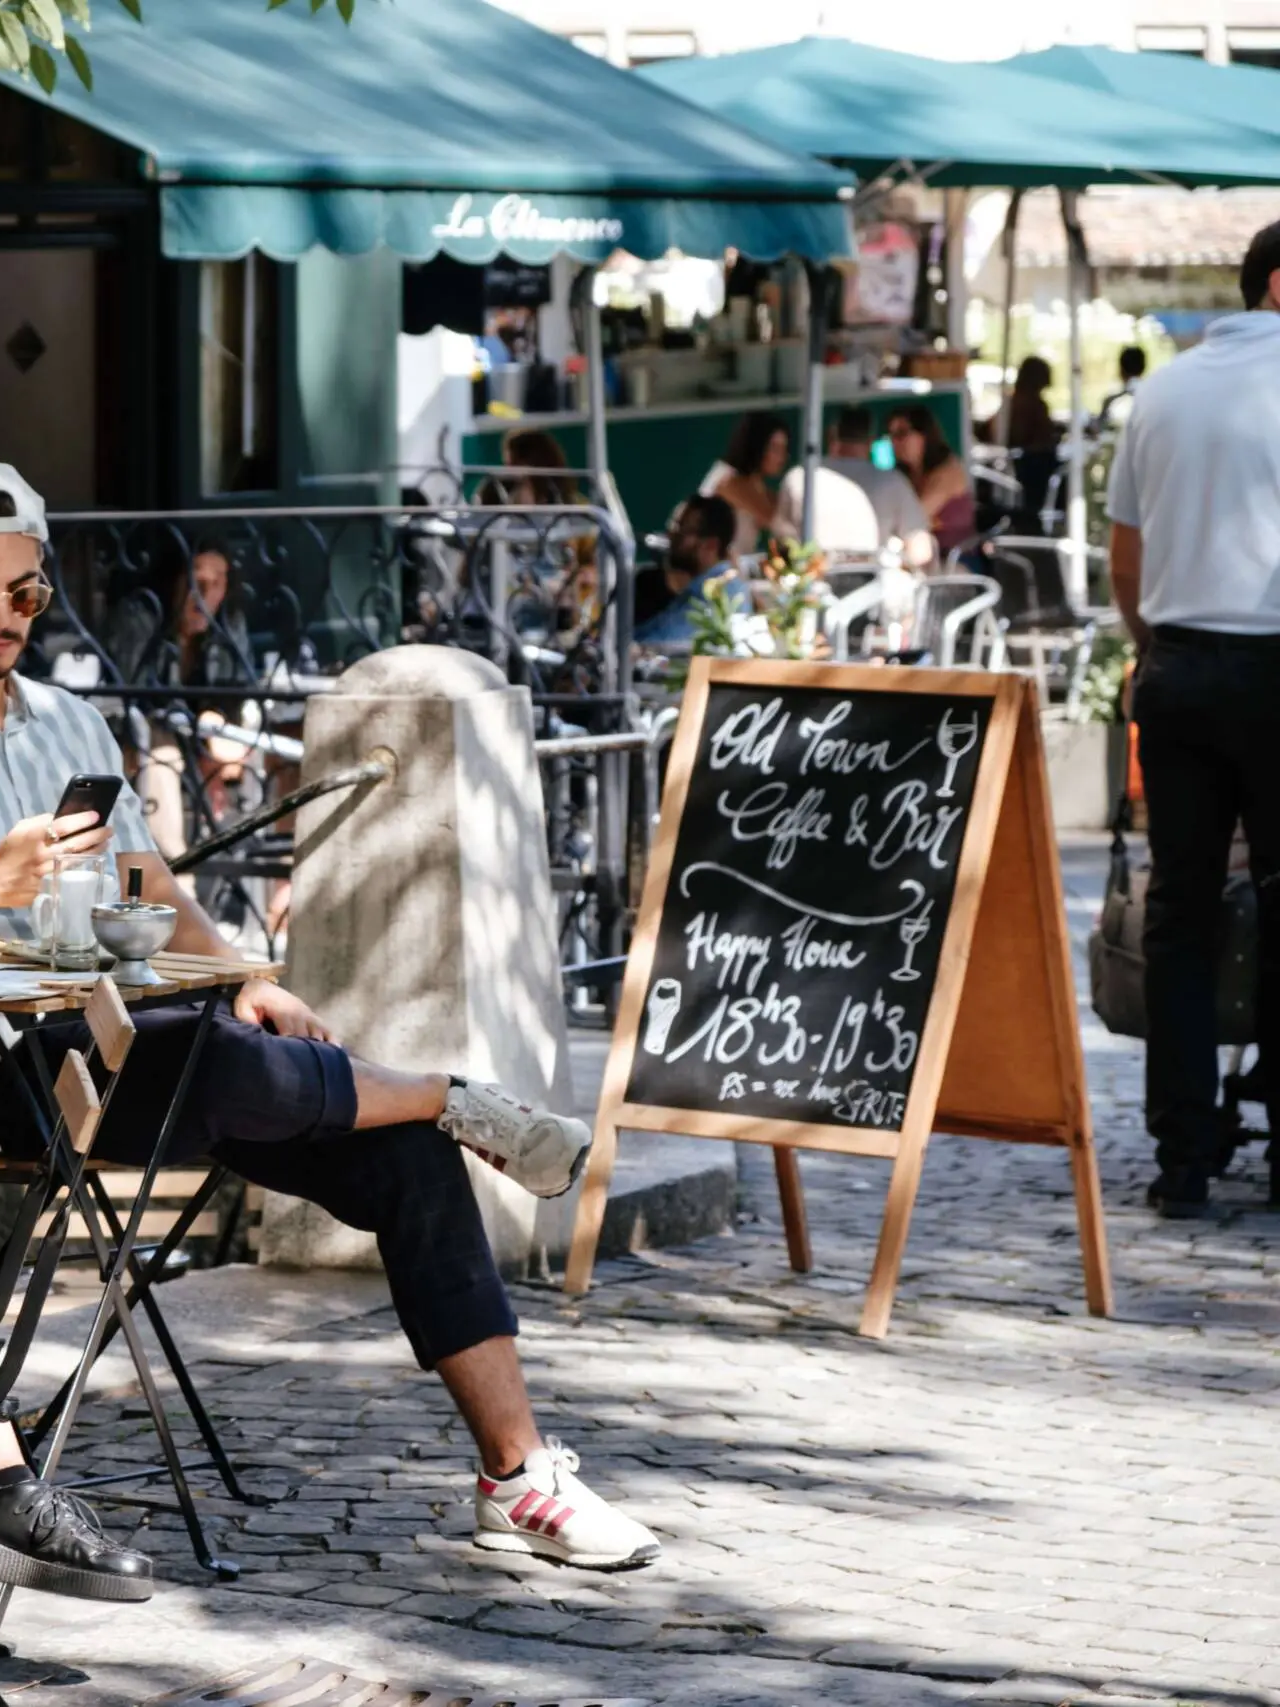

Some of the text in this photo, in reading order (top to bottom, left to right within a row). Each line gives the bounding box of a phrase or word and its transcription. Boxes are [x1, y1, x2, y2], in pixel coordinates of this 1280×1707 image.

[709, 697, 932, 775] Old Town
[716, 780, 963, 870] Coffee & Bar
[684, 912, 772, 995] Happy
